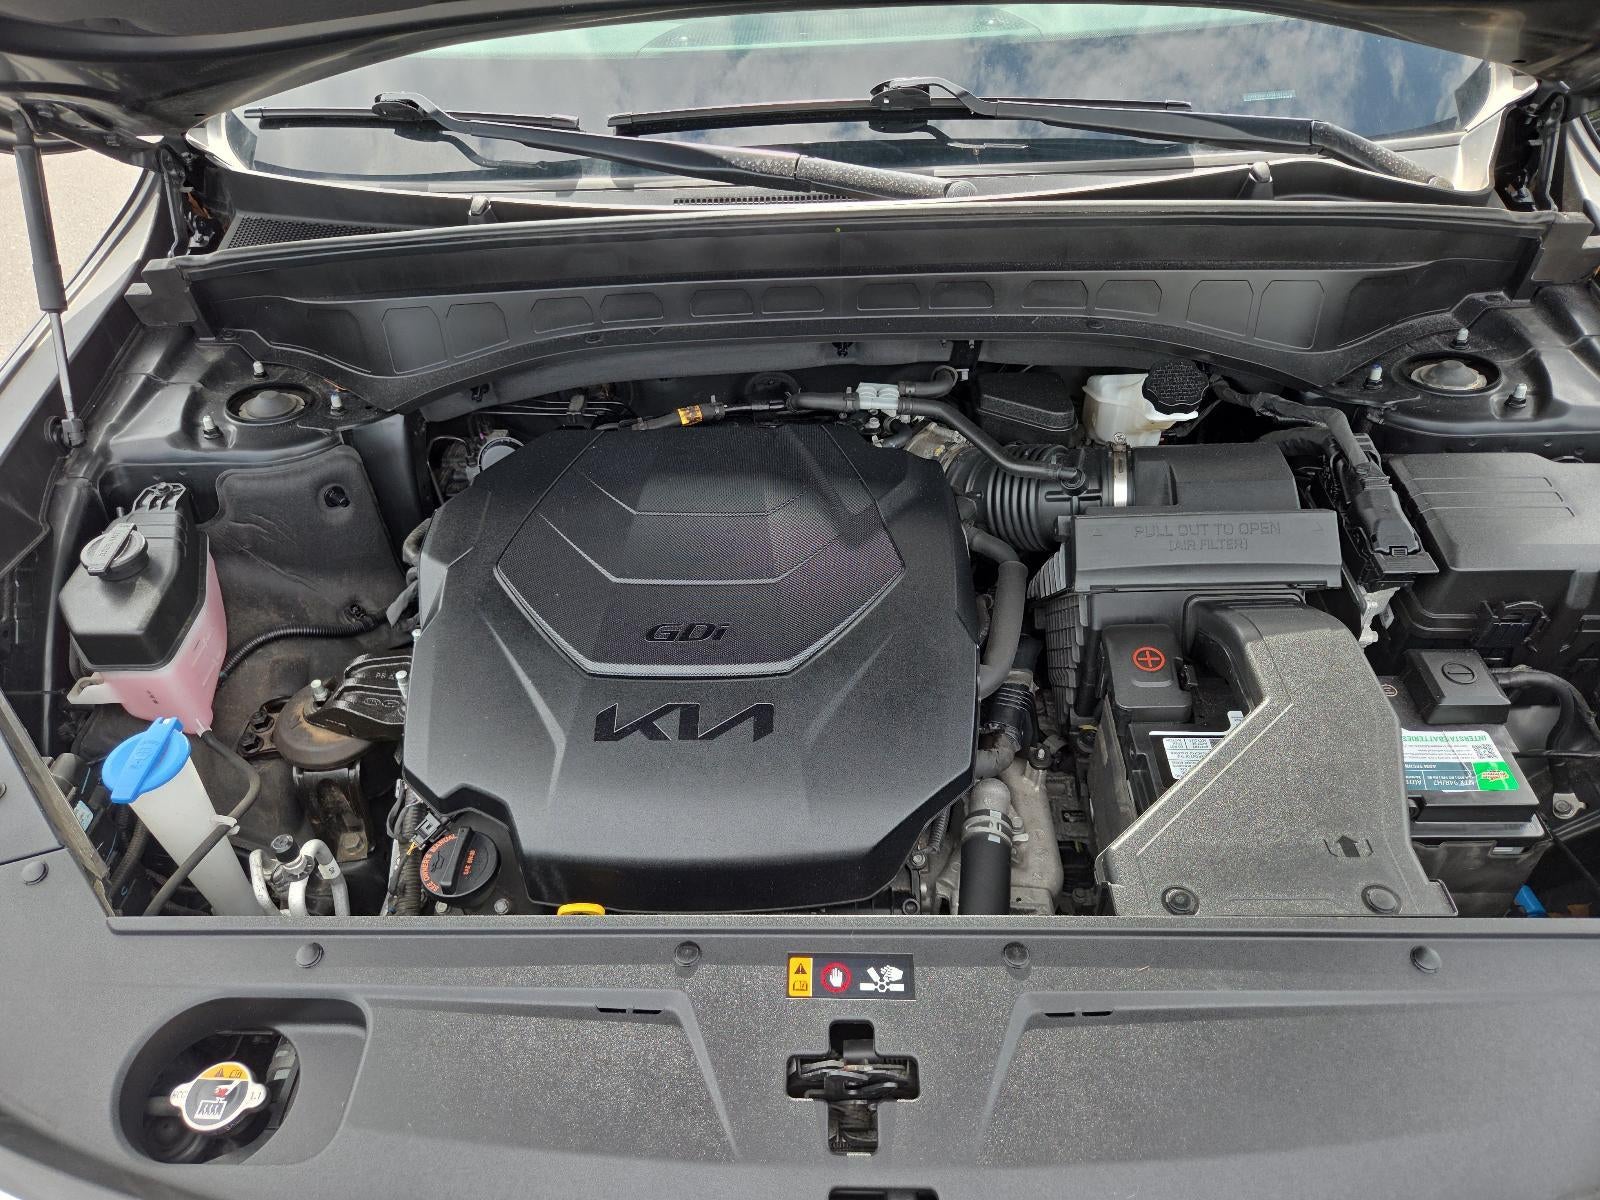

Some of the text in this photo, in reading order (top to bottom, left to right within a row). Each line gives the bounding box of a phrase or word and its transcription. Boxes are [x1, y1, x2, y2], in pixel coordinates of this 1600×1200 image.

[1134, 522, 1281, 538] PULL OUT TO OPEN
[645, 623, 730, 642] GDi
[594, 702, 775, 742] KIA
[430, 833, 457, 853] MANUAL
[426, 880, 439, 892] SEE
